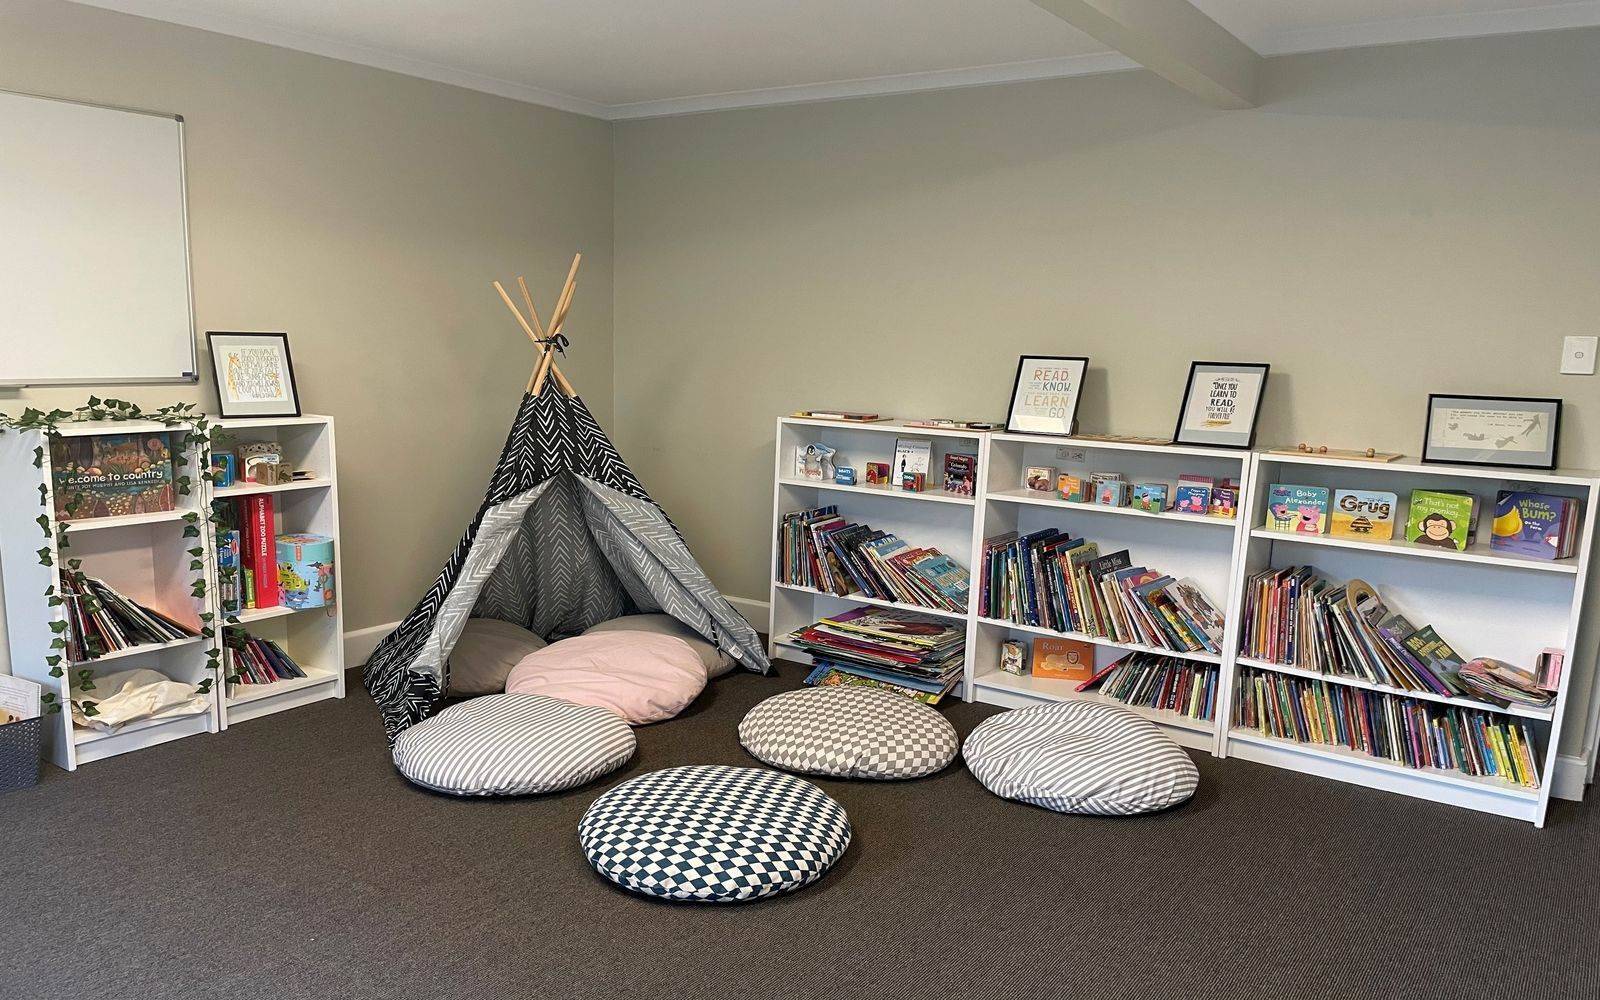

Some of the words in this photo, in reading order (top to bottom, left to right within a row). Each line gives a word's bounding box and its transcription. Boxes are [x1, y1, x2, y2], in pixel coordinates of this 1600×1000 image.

[1042, 382, 1071, 391] KNOW.
[107, 472, 121, 481] to
[123, 470, 163, 479] country
[1296, 489, 1317, 497] Baby
[1285, 497, 1326, 505] Alexander
[1519, 499, 1550, 510] Whose
[1340, 495, 1390, 519] Grug
[1417, 505, 1428, 513] my
[1042, 641, 1064, 651] Roar
